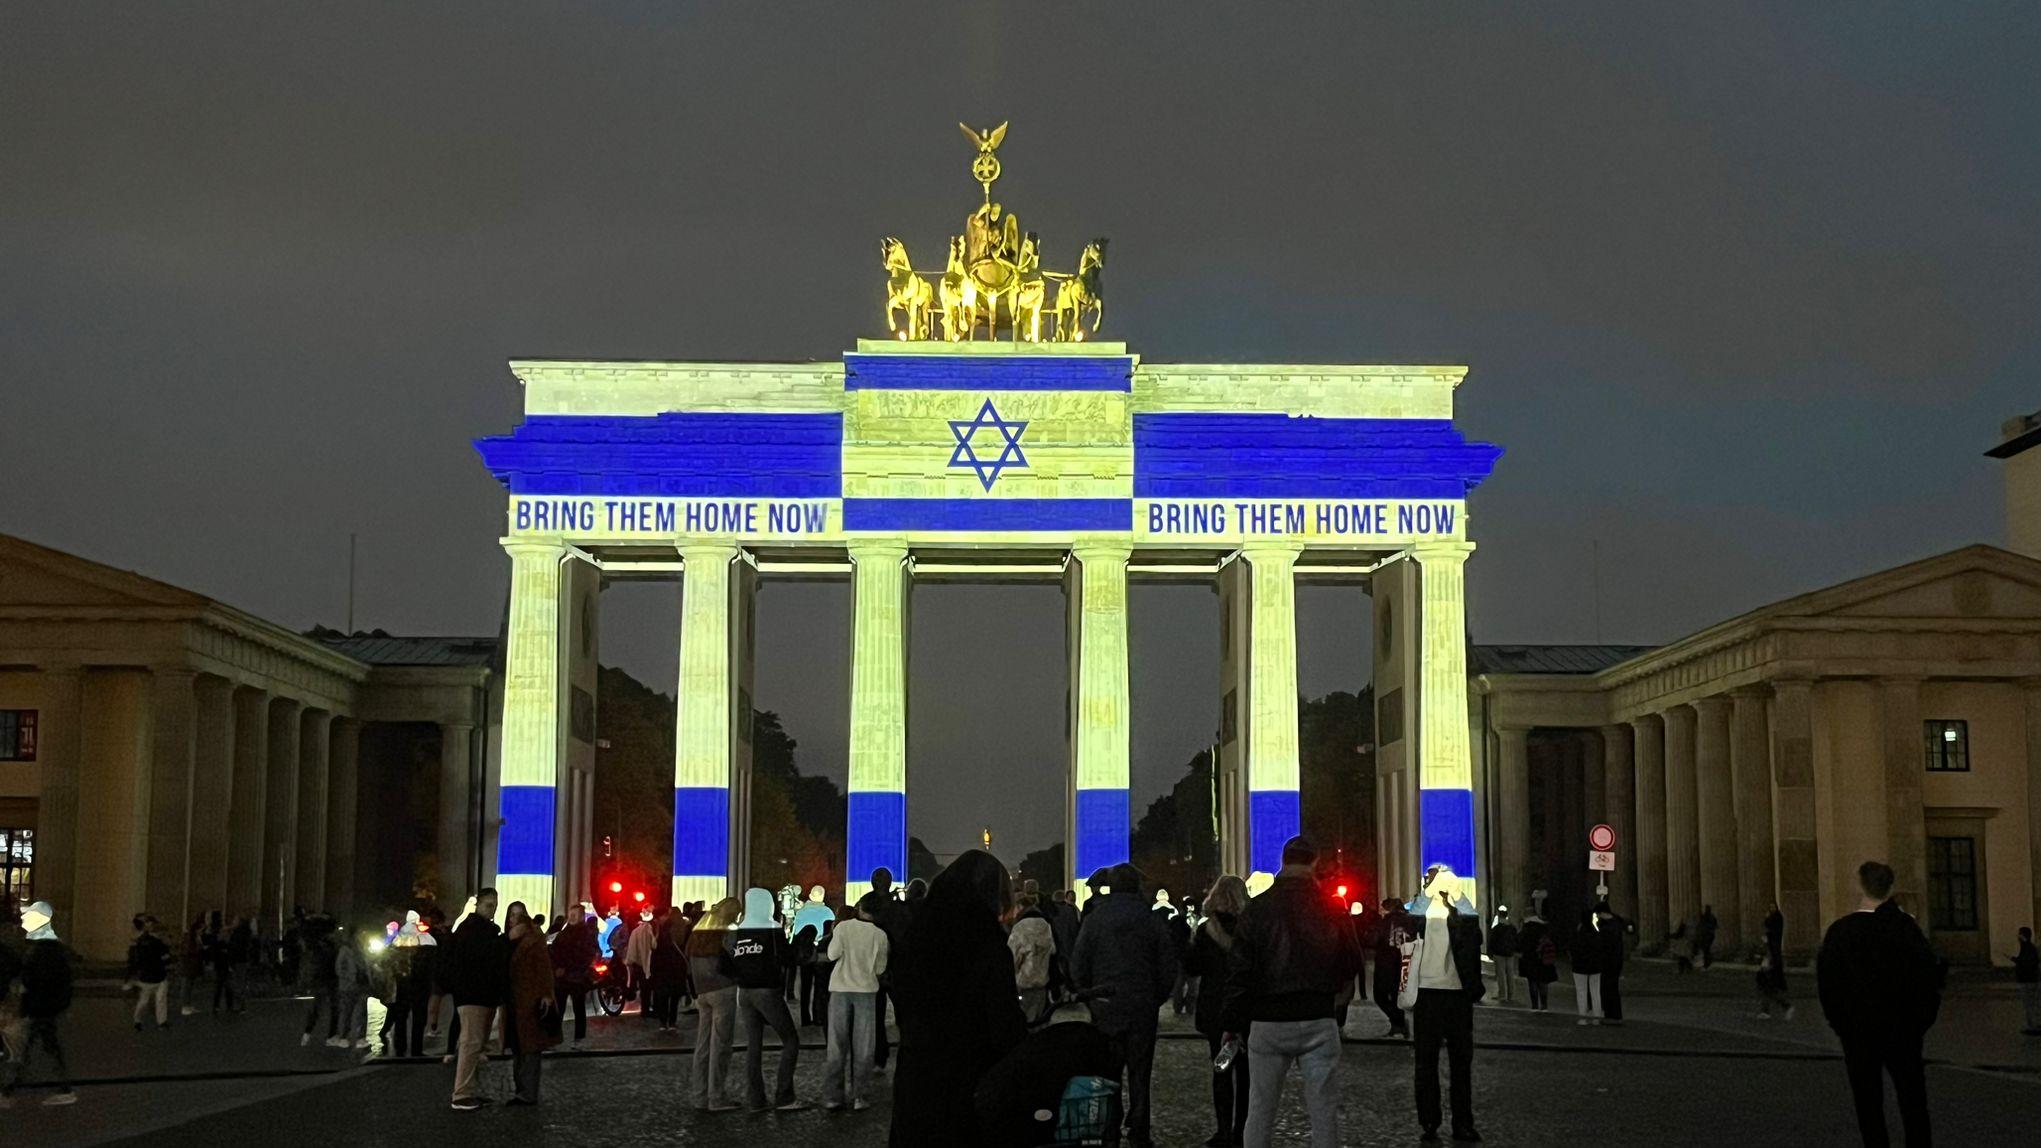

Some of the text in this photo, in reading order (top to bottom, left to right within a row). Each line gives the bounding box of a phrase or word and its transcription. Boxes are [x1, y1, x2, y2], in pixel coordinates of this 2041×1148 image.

[516, 501, 828, 533] BRING THEM HOME NOW
[1149, 503, 1455, 534] BRING THEM HOME NOW
